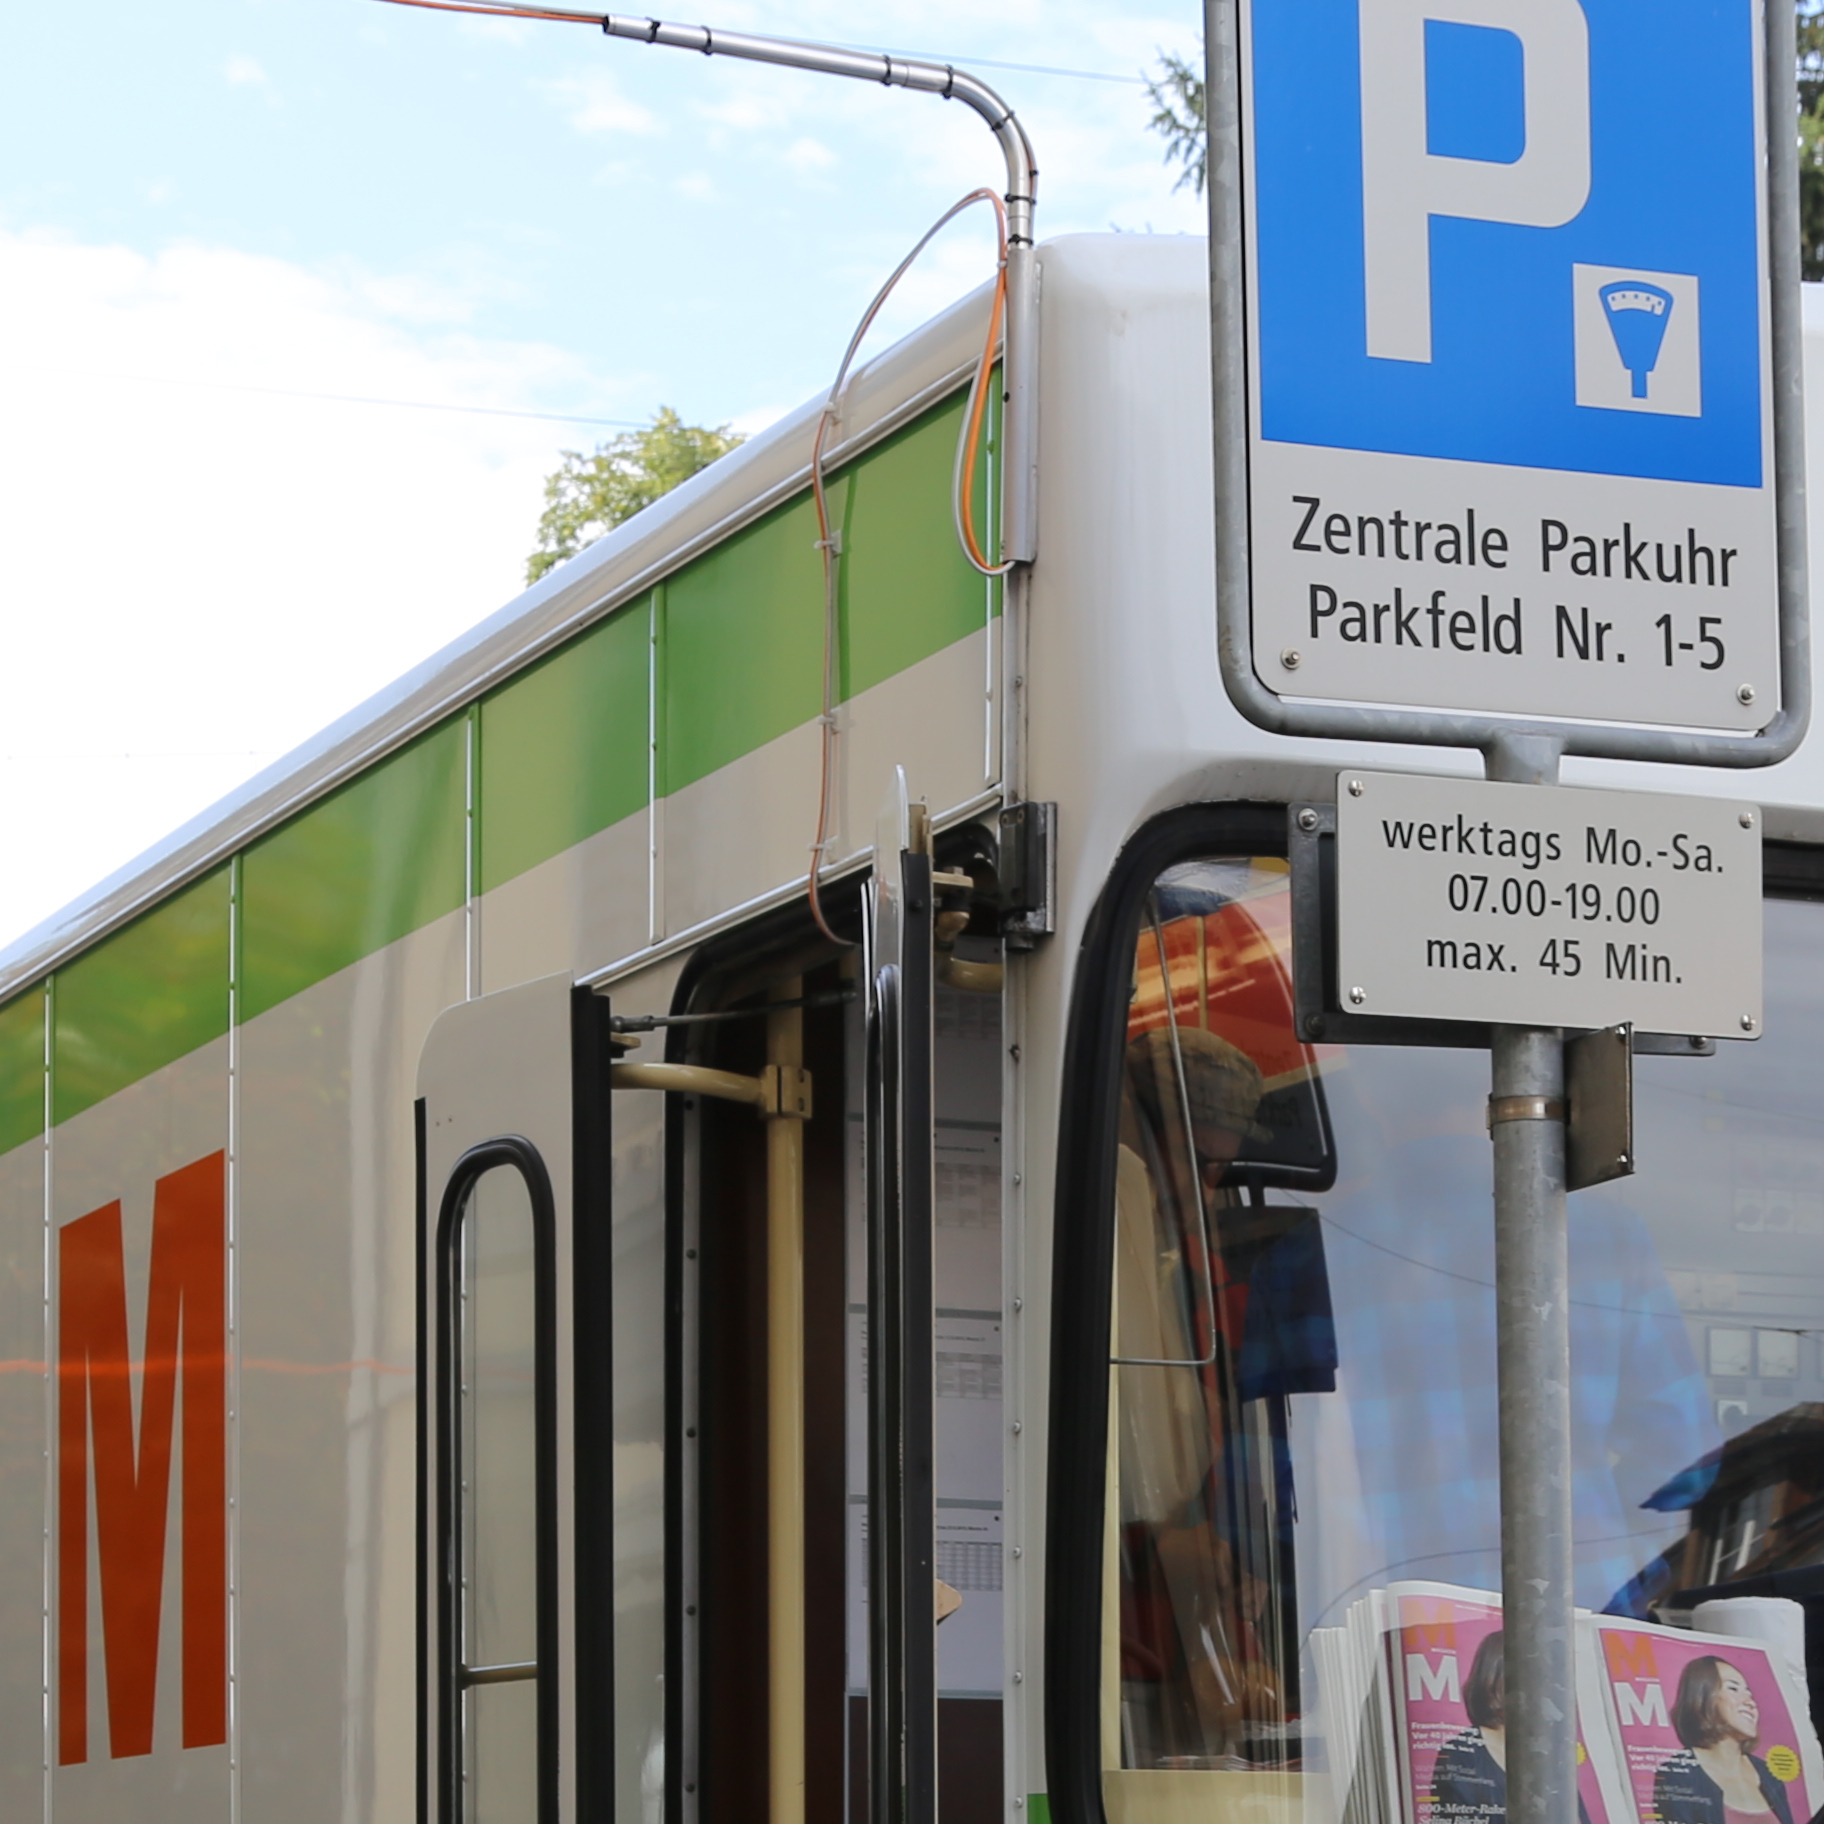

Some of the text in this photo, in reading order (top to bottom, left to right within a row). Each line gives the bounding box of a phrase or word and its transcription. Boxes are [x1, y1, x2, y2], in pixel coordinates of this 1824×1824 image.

[1360, 0, 1591, 363] P
[1291, 495, 1738, 589] Zentrale Parkuhr
[1308, 584, 1726, 670] Parkfeld Nr. 1-5
[1382, 813, 1724, 876] werktags Mo.-Sa.
[1447, 874, 1661, 926] 07.00-19.00
[1425, 936, 1683, 984] max. 45 Min.
[59, 1147, 227, 1767] M
[1406, 1653, 1461, 1703] M
[1604, 1632, 1658, 1676] M
[1613, 1682, 1670, 1727] M
[1417, 1803, 1507, 1815] 800-Meter-Rake
